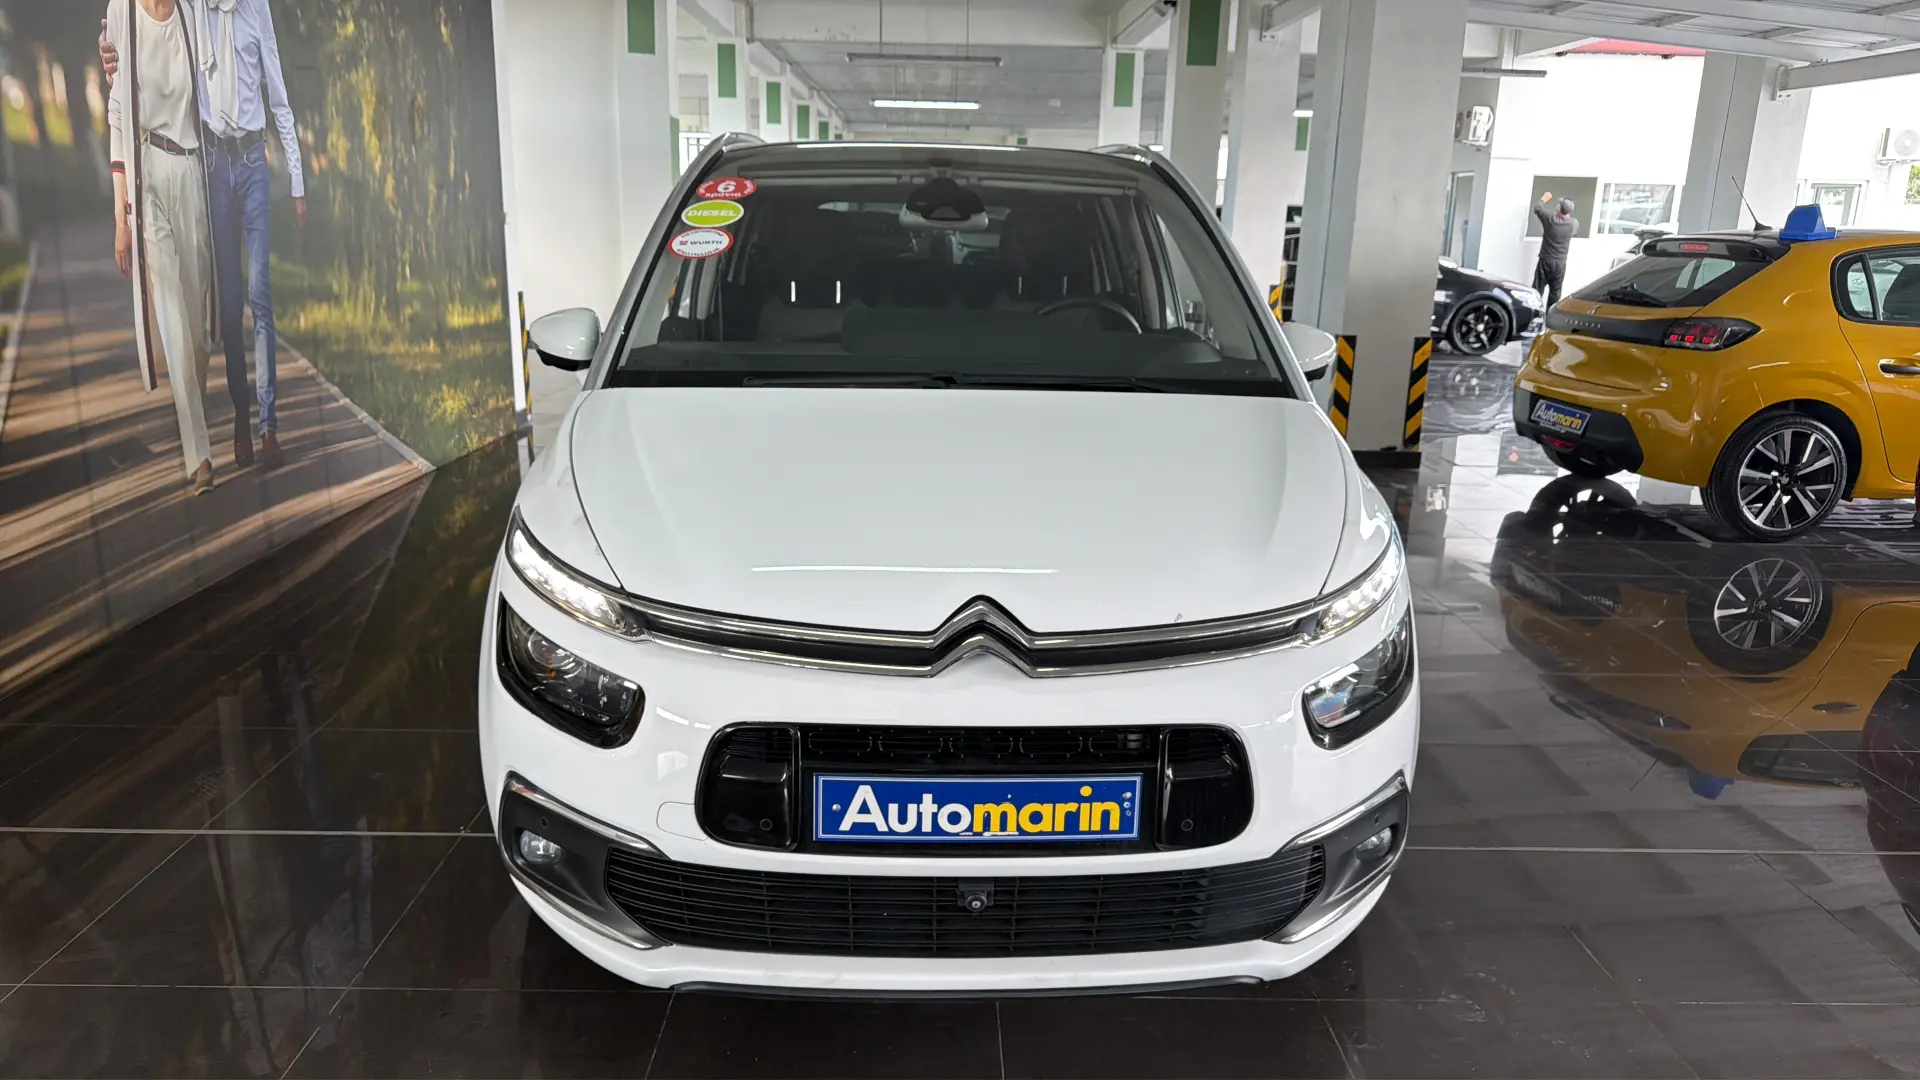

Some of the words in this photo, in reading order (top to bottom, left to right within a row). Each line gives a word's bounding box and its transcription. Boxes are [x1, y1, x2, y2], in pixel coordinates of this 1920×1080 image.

[717, 180, 737, 193] 6
[687, 209, 737, 217] DIESEL
[1535, 403, 1582, 430] Automarin
[838, 784, 1121, 834] Automarin
